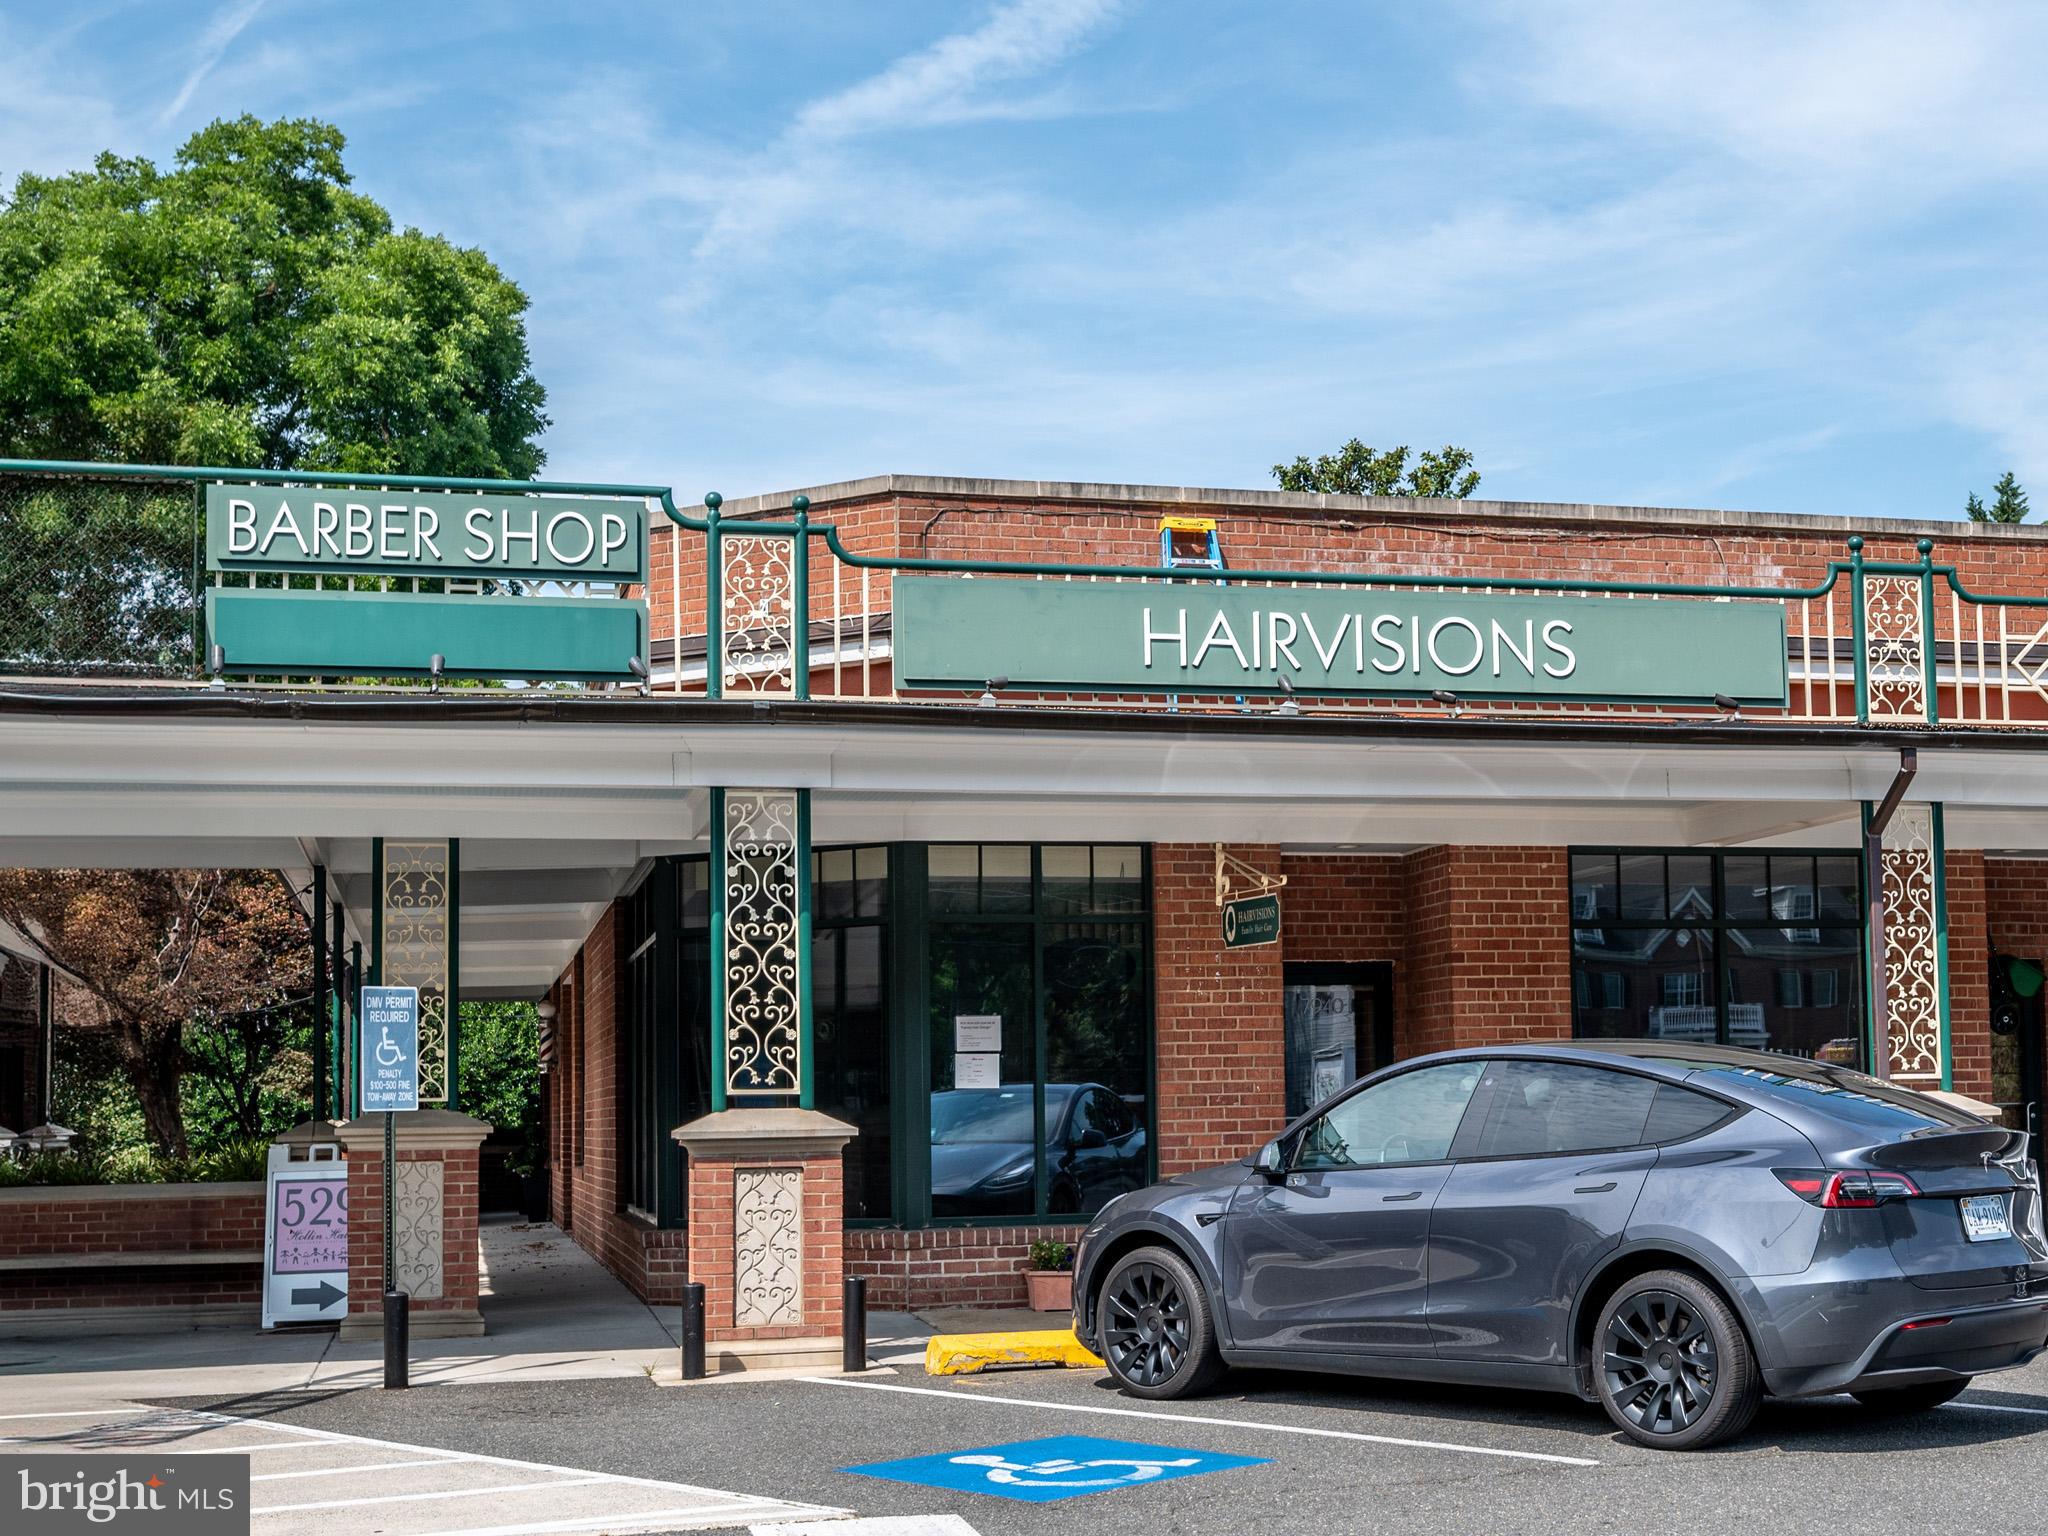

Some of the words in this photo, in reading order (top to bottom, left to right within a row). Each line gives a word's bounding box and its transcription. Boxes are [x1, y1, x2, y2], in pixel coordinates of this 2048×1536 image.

[228, 499, 442, 559] BARBER
[463, 508, 628, 565] SHOP
[1143, 607, 1576, 677] HAIRVISIONS
[1238, 906, 1275, 924] HAIRVISIONS
[366, 996, 383, 1009] DMV
[385, 996, 413, 1009] PERMIT
[370, 1010, 410, 1023] REQUIRED
[378, 1069, 402, 1079] PENALTY
[370, 1080, 397, 1090] $100-500
[398, 1080, 411, 1090] FINE
[367, 1091, 397, 1102] TOW-AWAY
[398, 1091, 414, 1102] ZONE
[287, 1229, 322, 1241] Hollin
